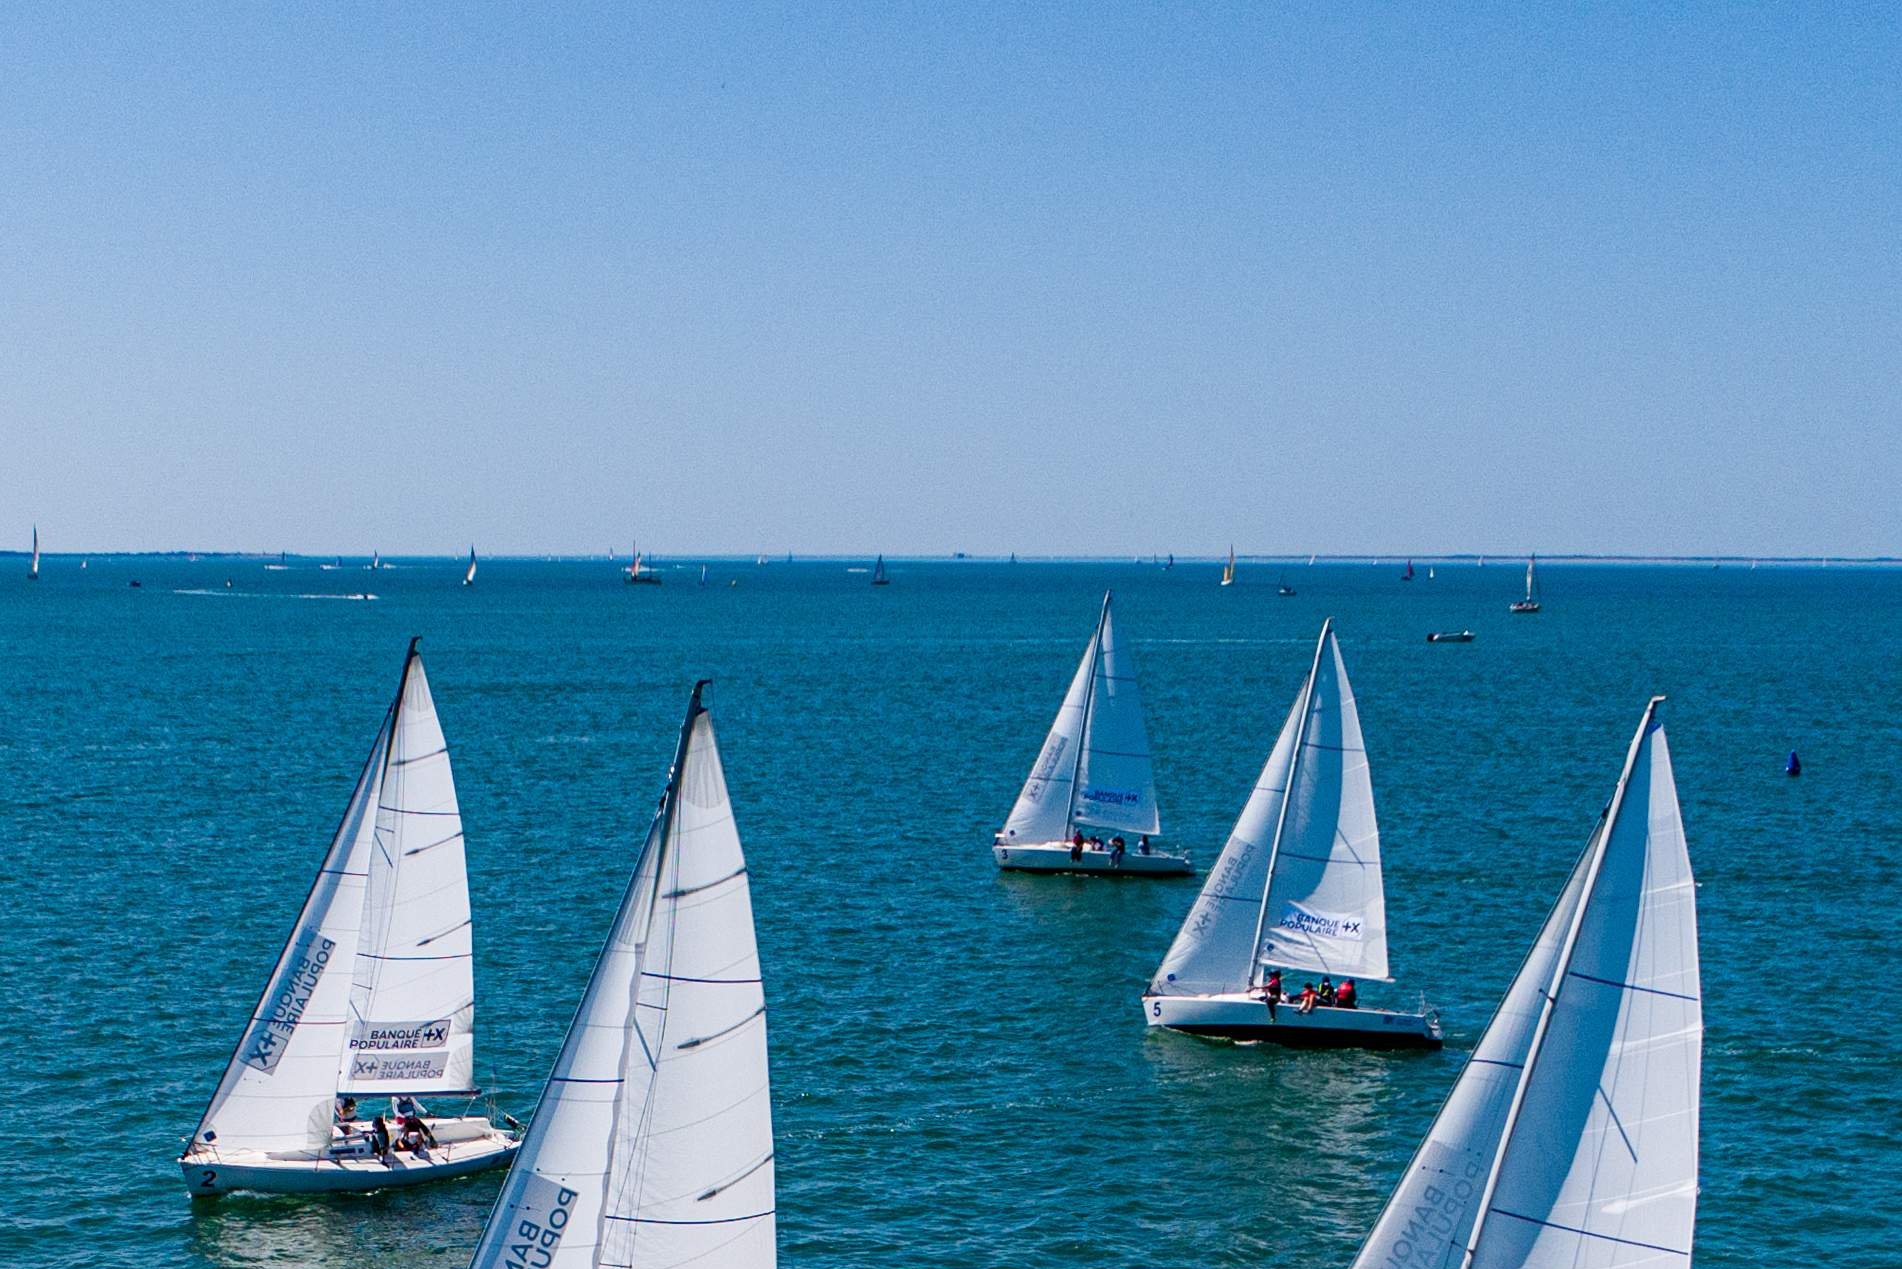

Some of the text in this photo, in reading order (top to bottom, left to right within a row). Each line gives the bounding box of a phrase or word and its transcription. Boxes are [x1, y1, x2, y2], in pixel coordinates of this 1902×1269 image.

[1001, 850, 1008, 860] 3
[1153, 1001, 1162, 1017] 5
[370, 1028, 422, 1040] BANQUE
[349, 1039, 419, 1050] POPULAIRE
[201, 1170, 217, 1188] 2
